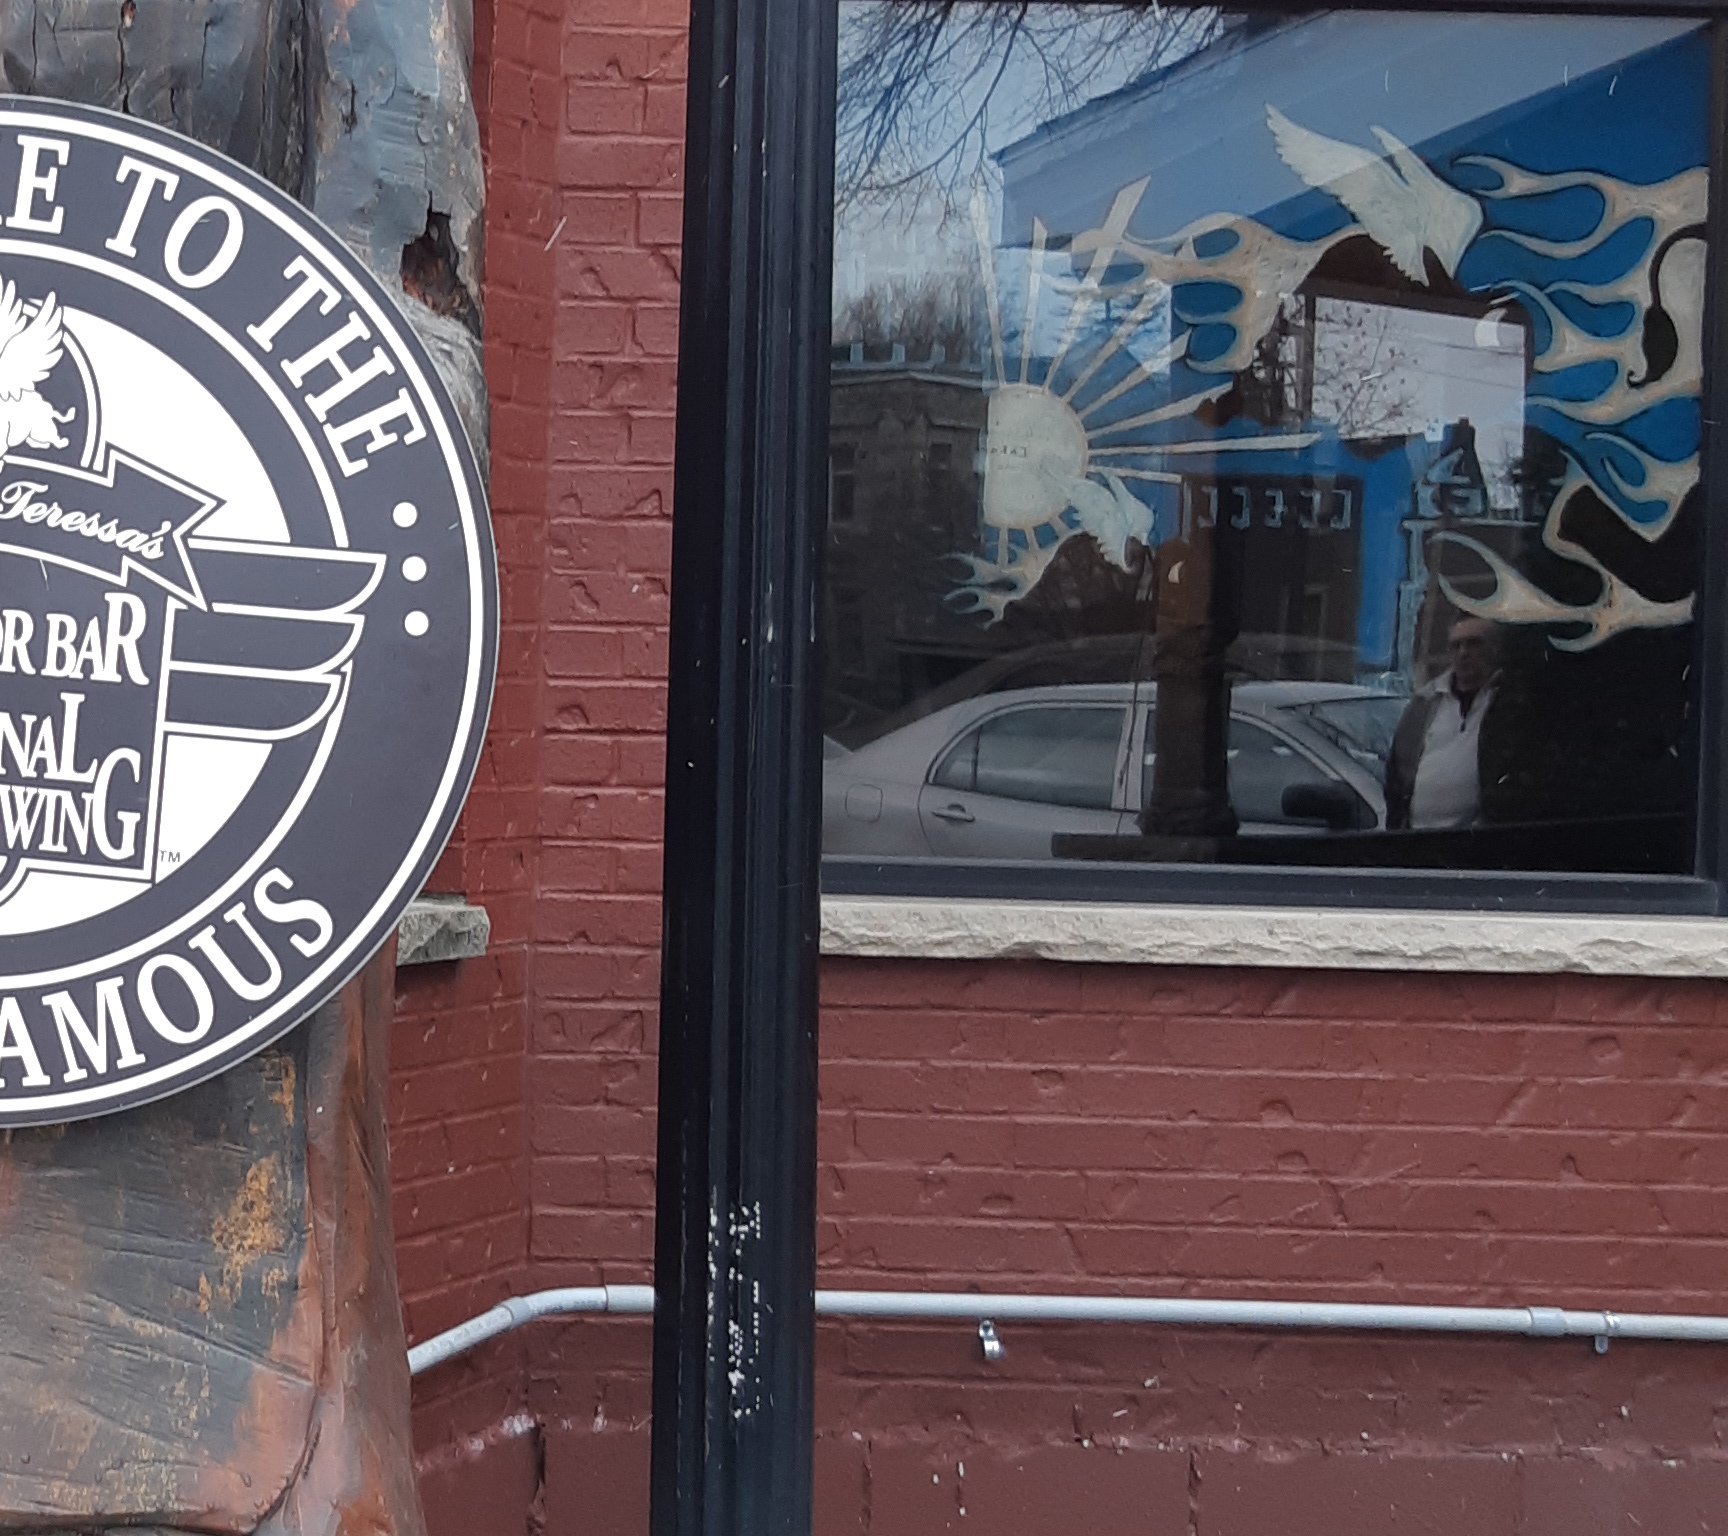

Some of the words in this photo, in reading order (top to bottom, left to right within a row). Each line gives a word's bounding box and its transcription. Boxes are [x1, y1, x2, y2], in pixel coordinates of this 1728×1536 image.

[103, 154, 245, 290] TO
[246, 255, 429, 477] THE
[41, 592, 150, 686] BAR
[158, 849, 181, 863] TM
